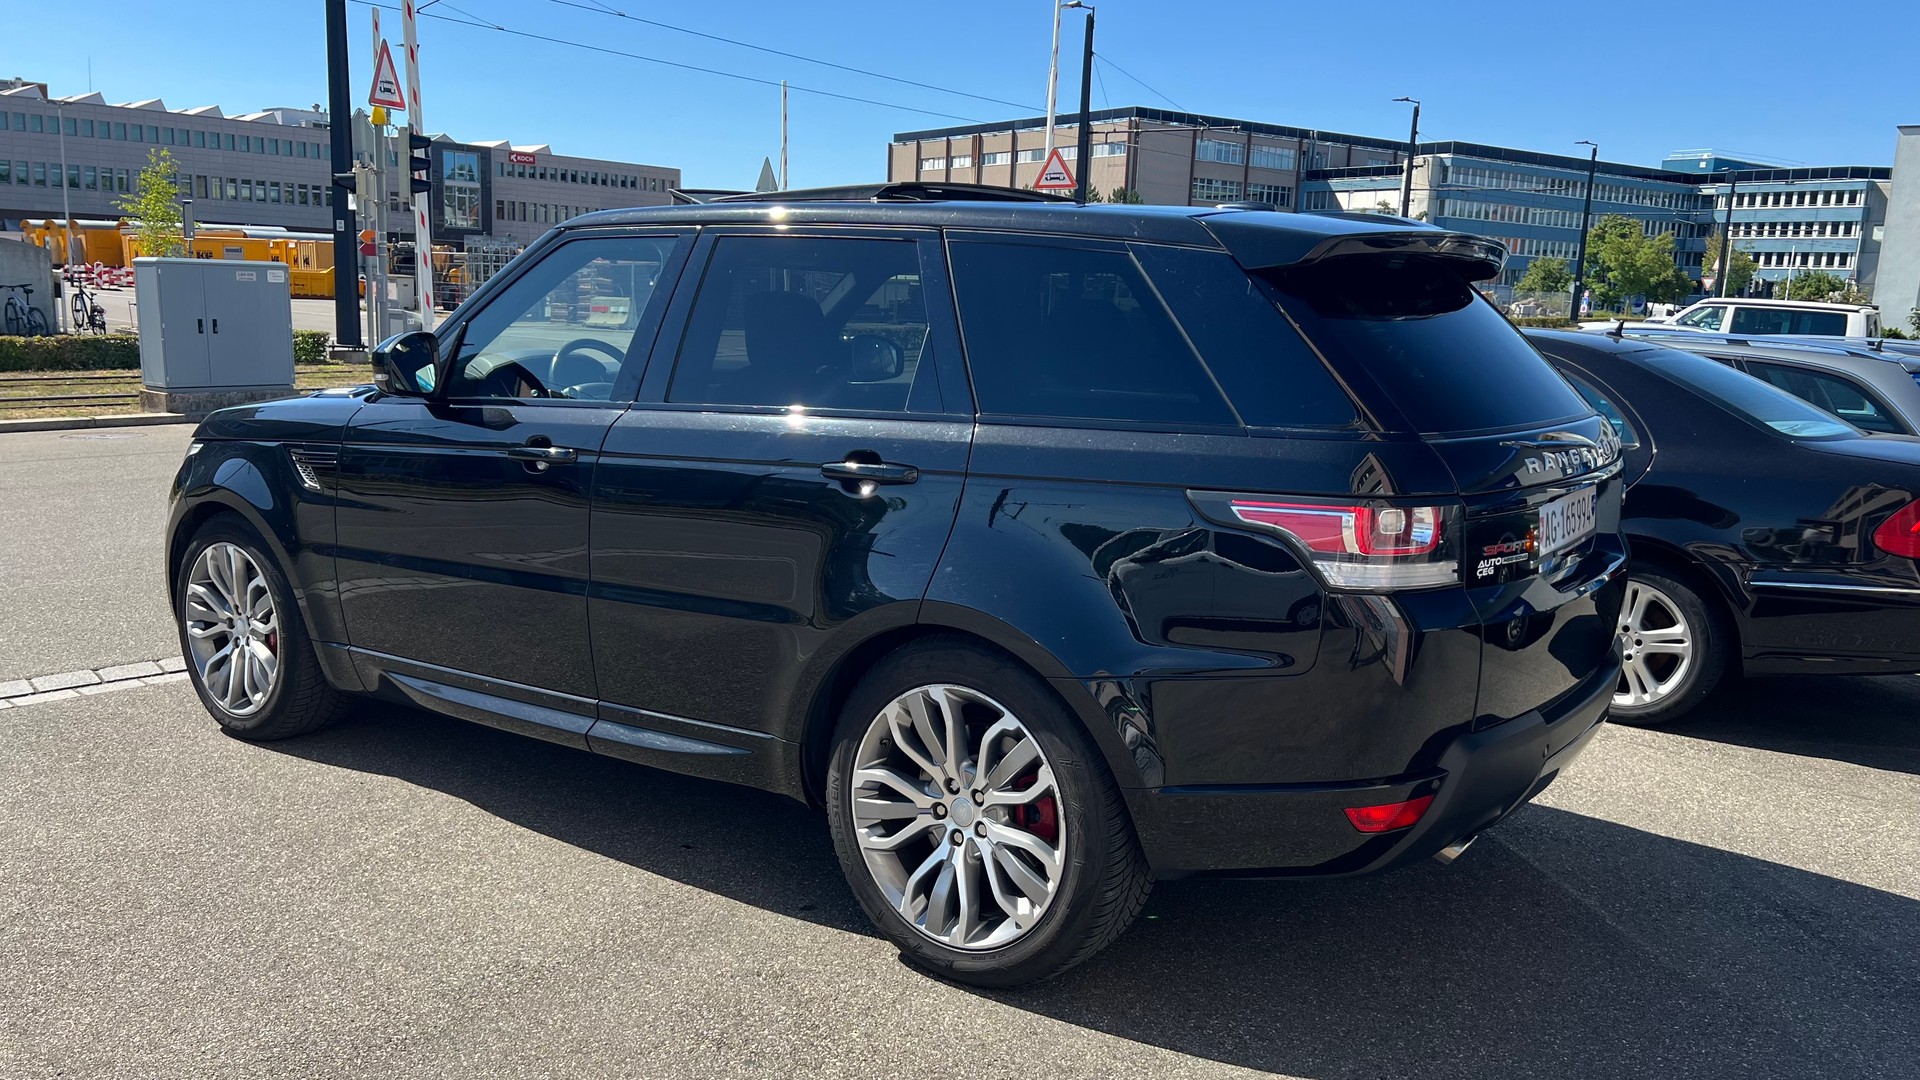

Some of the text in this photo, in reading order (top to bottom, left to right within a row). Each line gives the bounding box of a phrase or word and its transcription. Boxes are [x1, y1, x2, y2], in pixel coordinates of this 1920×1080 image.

[516, 154, 534, 162] KOCH
[1524, 447, 1593, 474] RANGE
[1482, 539, 1531, 556] SPORT
[1477, 557, 1502, 569] AUTO
